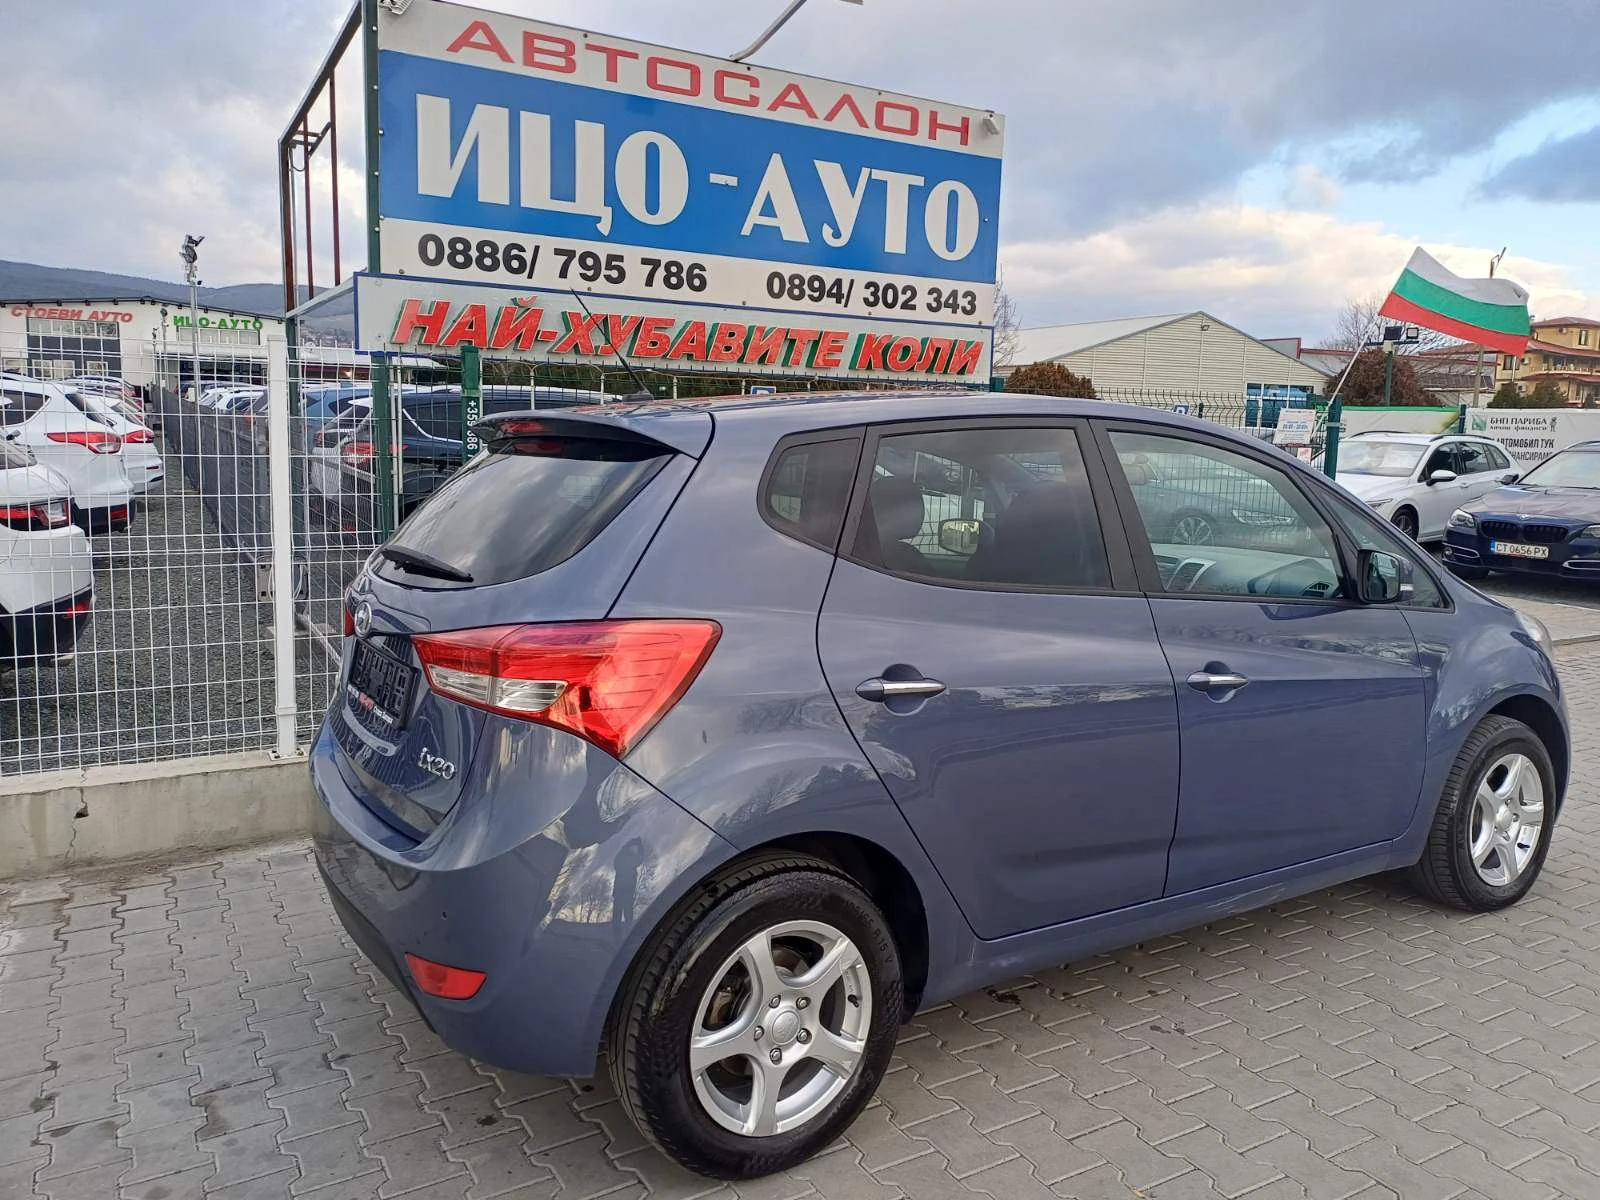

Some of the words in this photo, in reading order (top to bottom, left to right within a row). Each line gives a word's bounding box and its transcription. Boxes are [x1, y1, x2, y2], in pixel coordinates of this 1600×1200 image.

[446, 20, 971, 146] АВТОСАЛОН
[417, 233, 540, 279] 0886/
[553, 248, 626, 284] 795
[640, 257, 707, 292] 786
[10, 306, 83, 321] СТОЕВИ
[88, 310, 134, 323] АУТО
[766, 271, 855, 308] 0894/
[862, 281, 917, 310] 302
[926, 287, 977, 316] 343
[390, 295, 849, 369] НАЙ-ХУБАВИТЕ
[850, 332, 984, 376] КОЛИ
[1490, 417, 1509, 425] БНП
[1511, 417, 1547, 425] ПАРИБА
[1540, 438, 1555, 448] ТУК
